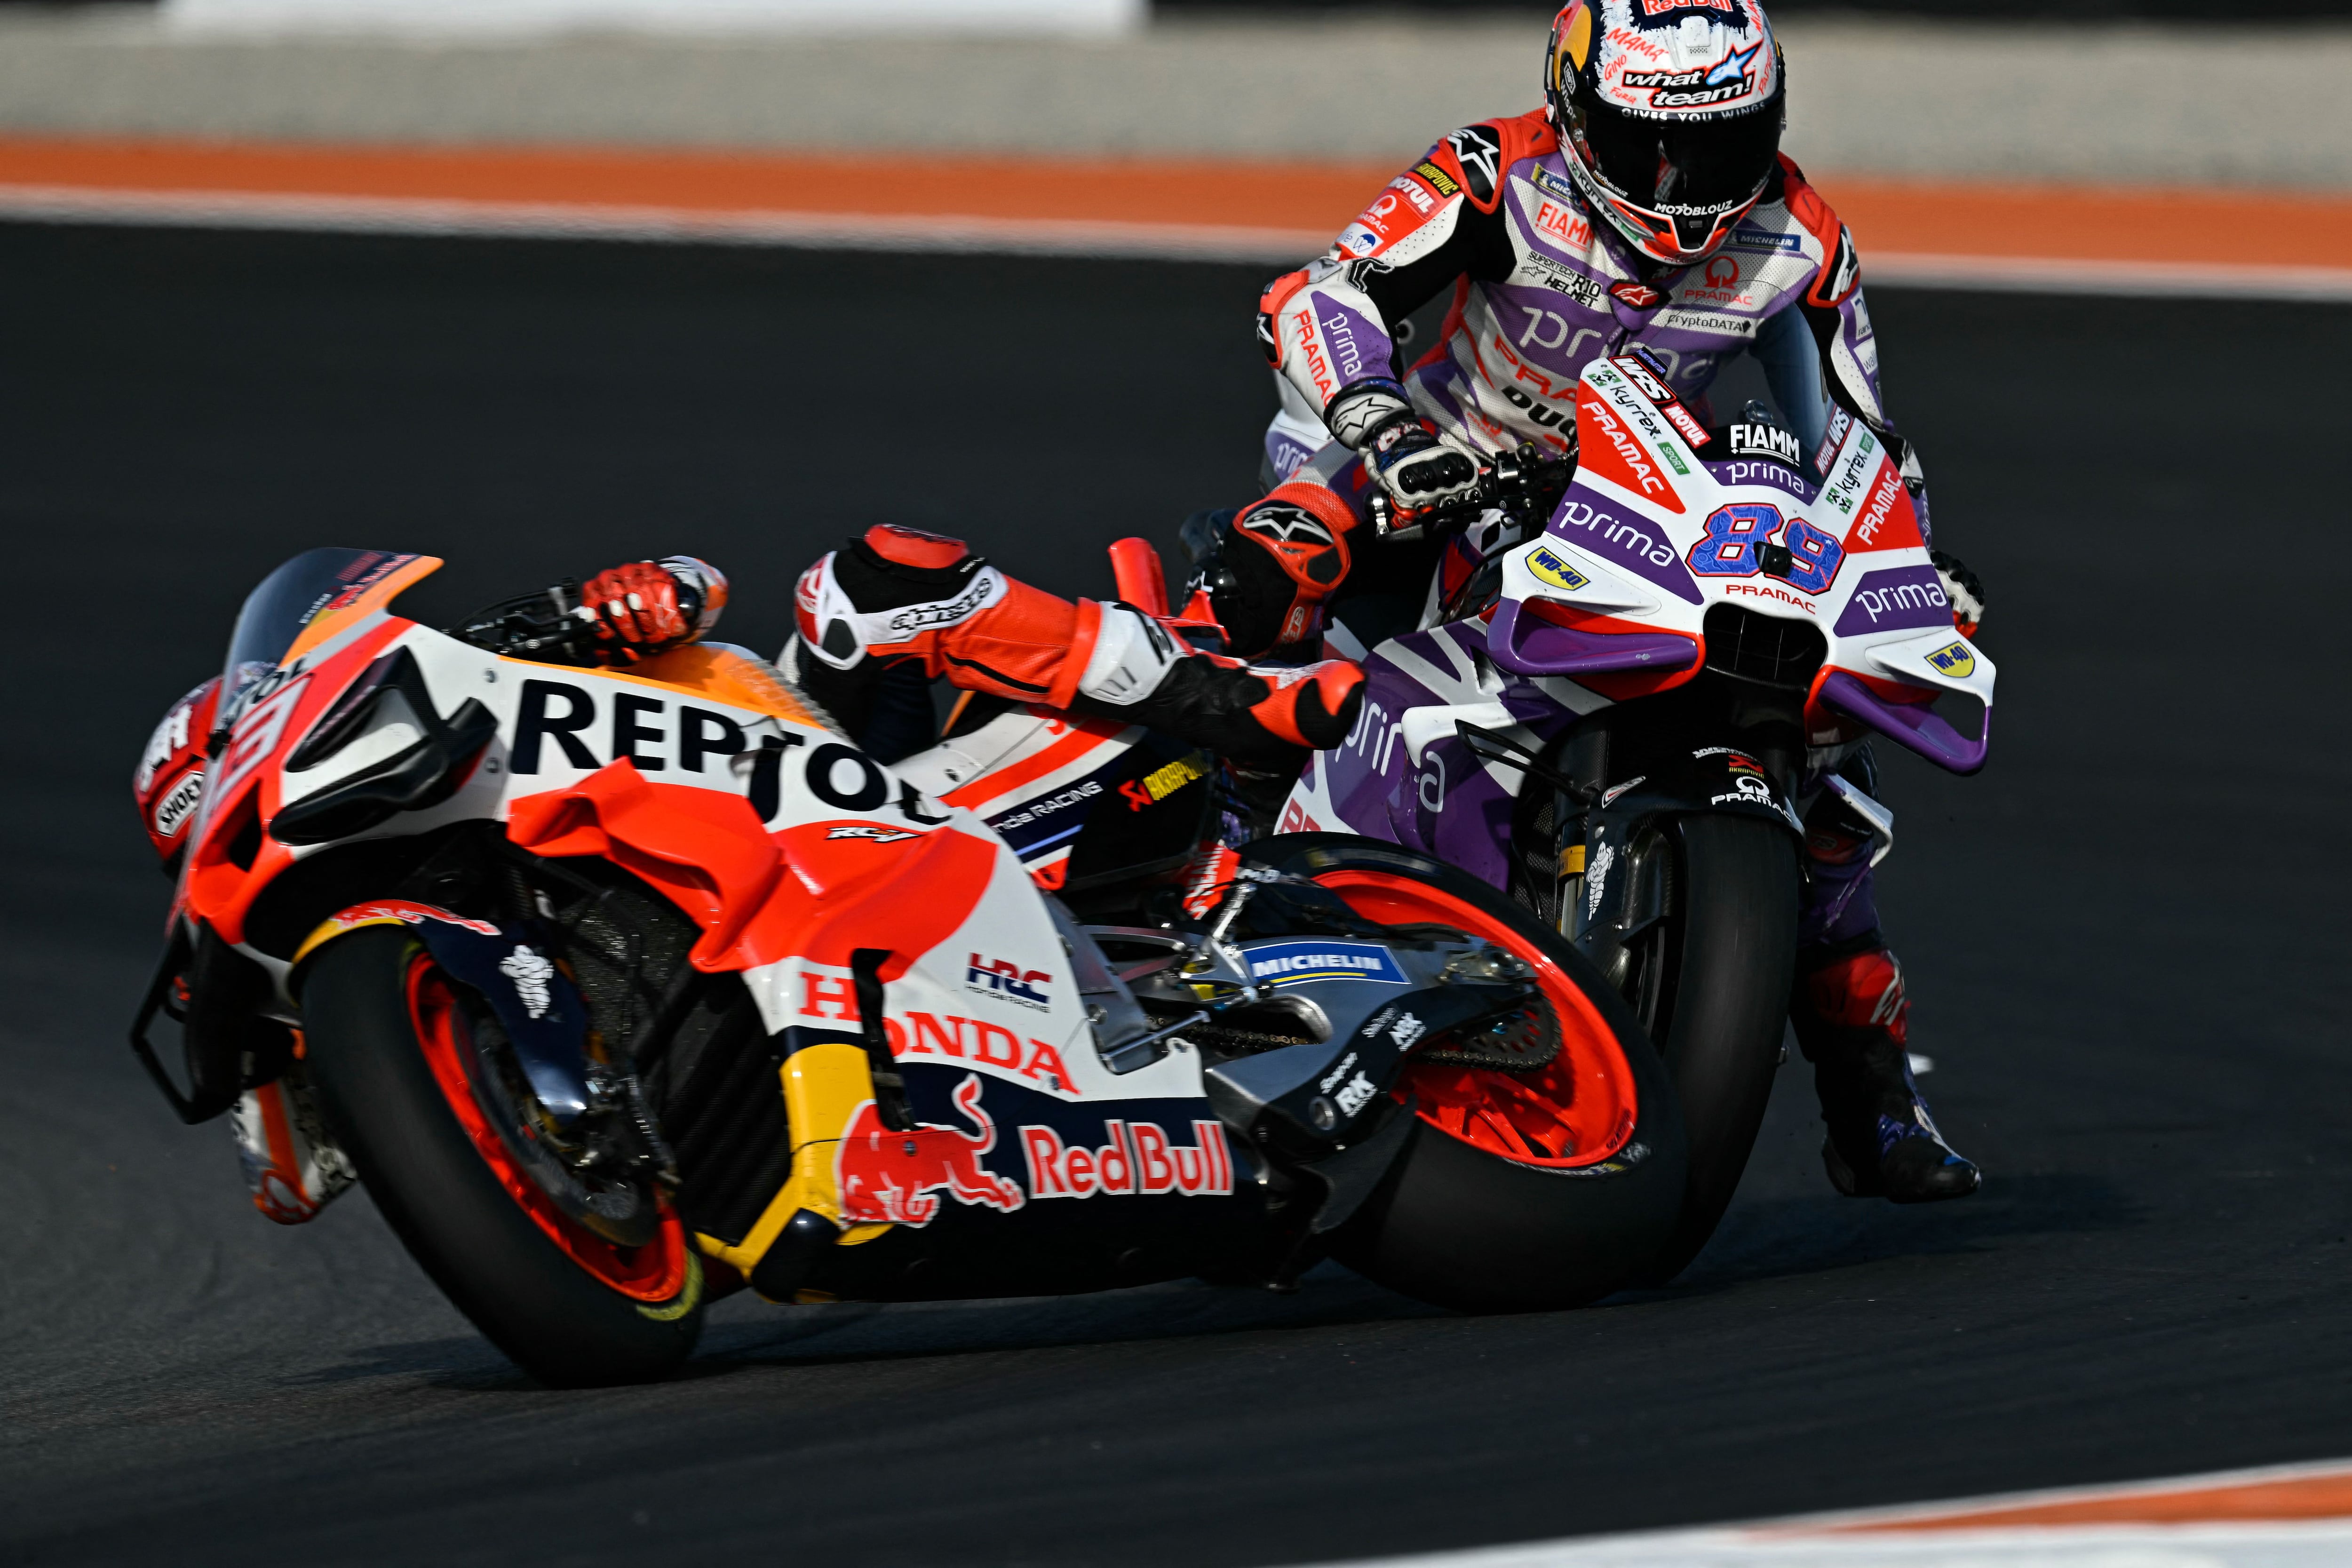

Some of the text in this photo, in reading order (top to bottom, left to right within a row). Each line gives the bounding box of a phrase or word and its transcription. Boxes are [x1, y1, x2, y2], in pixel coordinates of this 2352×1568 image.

[1604, 55, 1627, 81] GINO
[1625, 71, 1703, 87] what
[1653, 74, 1753, 107] team!
[1622, 101, 1766, 123] GIVES YOU WINGS
[1359, 213, 1390, 234] AMAC
[1654, 199, 1733, 216] MOTOBLOUZ
[1740, 235, 1795, 246] MICHELIN
[1528, 251, 1602, 298] SUPERTECH R10
[1544, 274, 1598, 308] HELMET
[1684, 289, 1753, 306] PRAMAC
[1293, 309, 1336, 409] PRAMAC
[1321, 311, 1362, 376] prima
[1494, 333, 1579, 404] PRA
[1502, 385, 1578, 452] DUC
[1665, 405, 1707, 446] MOTUL
[1581, 401, 1665, 494] PRAMAC
[1662, 446, 1685, 471] SPORT
[1730, 424, 1800, 462] FIAMM
[1817, 440, 1835, 474] MOTUL
[1725, 462, 1804, 495] prima
[1856, 472, 1902, 546] PRAMAC
[1558, 501, 1675, 567] prima
[1685, 503, 1847, 596] 89
[1534, 550, 1583, 586] WD-40
[1726, 584, 1816, 615] PRAMAC
[1855, 582, 1947, 623] prima
[1930, 645, 1971, 670] WD-40
[1029, 781, 1104, 817] RACING
[1711, 793, 1793, 823] PRAMAC
[966, 952, 1054, 1005] HRC
[1252, 952, 1383, 979] MICHELIN
[1018, 1119, 1234, 1199] Red Bull
